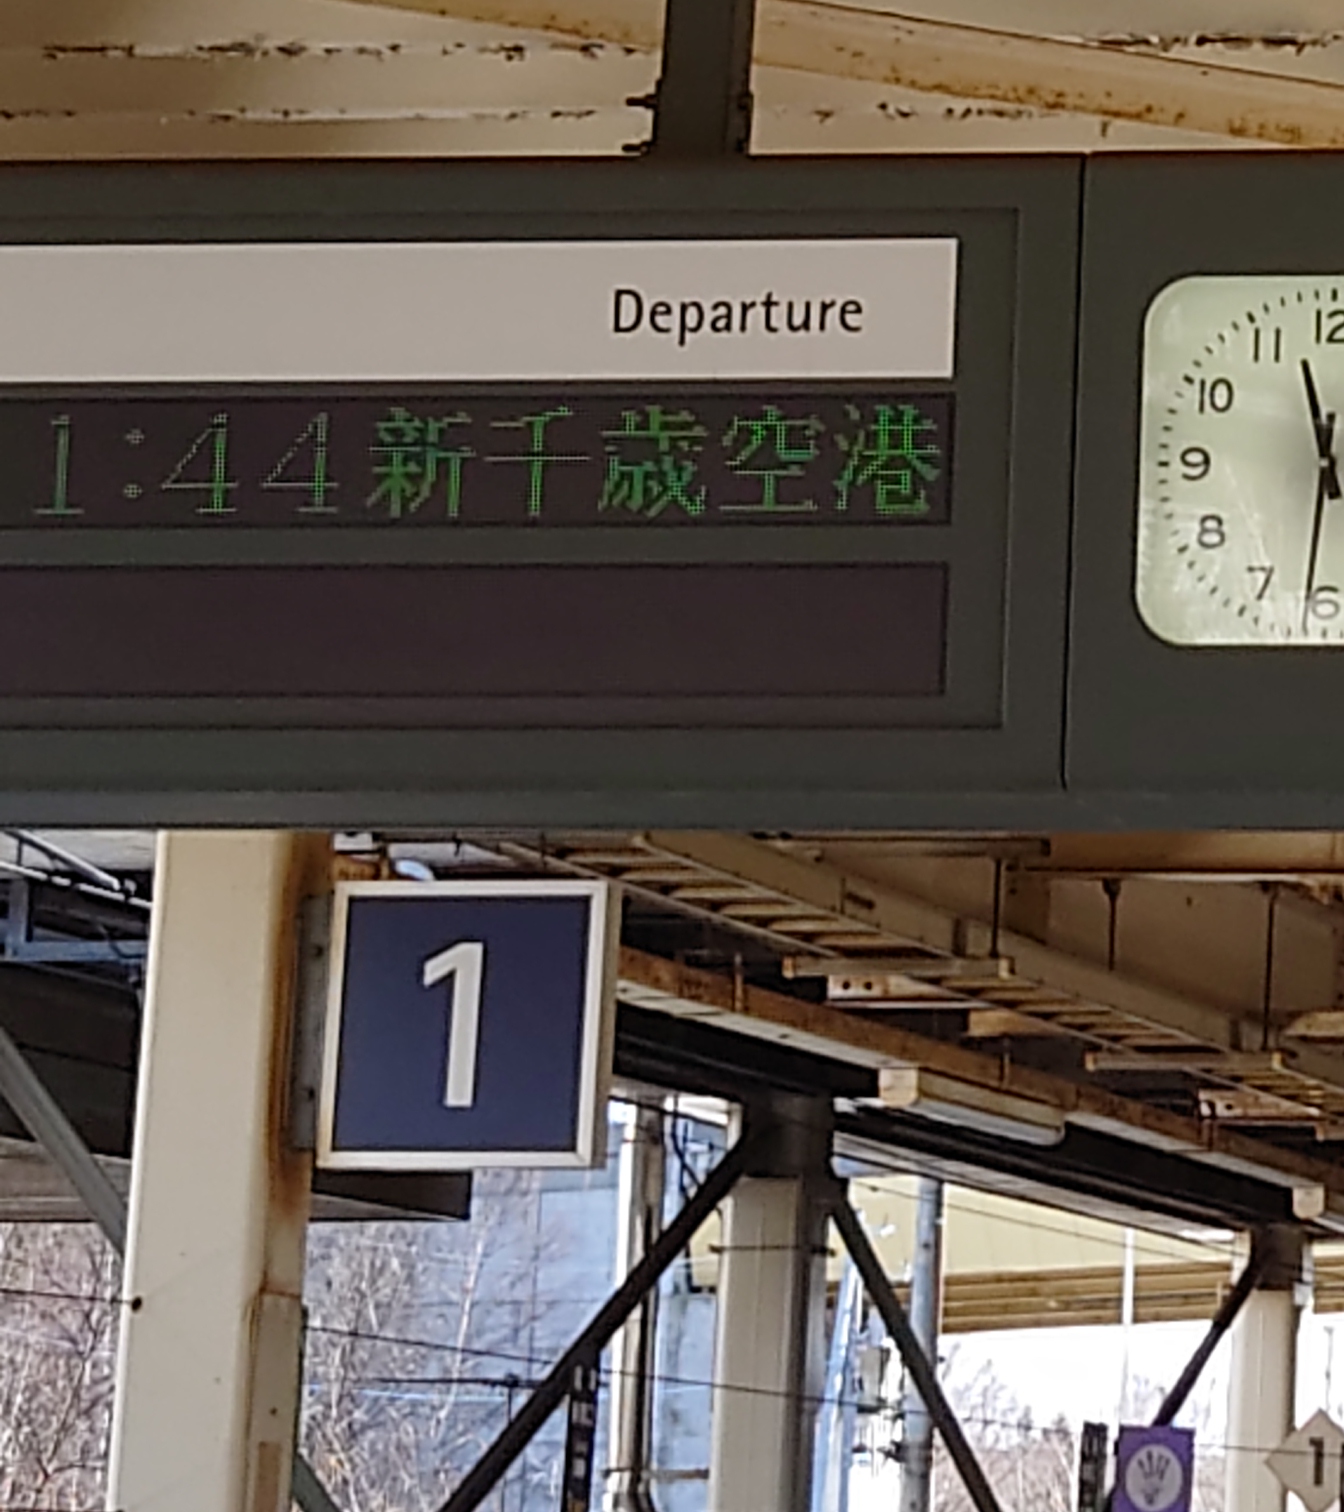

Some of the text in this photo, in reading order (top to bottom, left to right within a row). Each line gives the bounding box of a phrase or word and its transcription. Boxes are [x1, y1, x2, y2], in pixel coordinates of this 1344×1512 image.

[611, 288, 864, 347] Departure
[1253, 326, 1282, 364] 11
[1197, 377, 1235, 414] 10
[367, 404, 942, 519] 新千歳空港
[1179, 446, 1212, 482] 9
[1196, 514, 1226, 550] 8
[1246, 565, 1275, 602] 7
[1310, 586, 1340, 621] 6
[421, 939, 485, 1109] 1
[1309, 1437, 1325, 1486] 1
